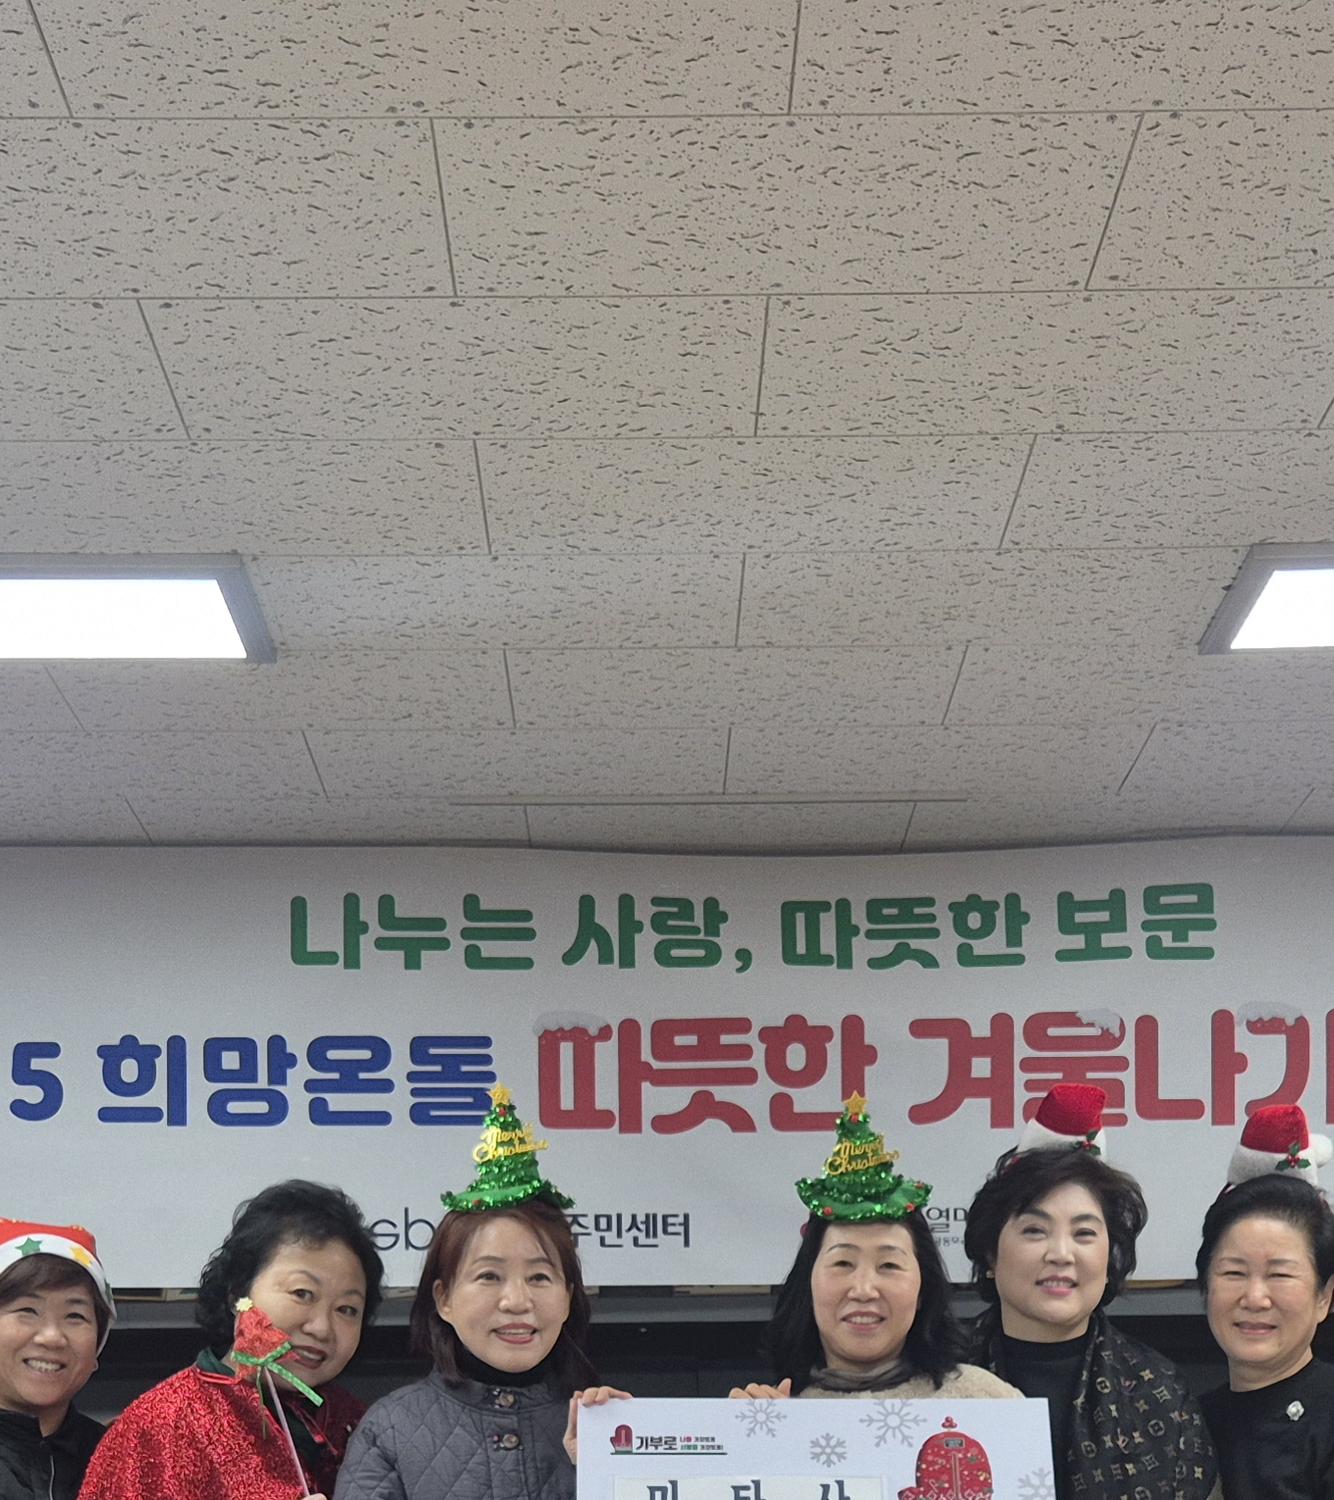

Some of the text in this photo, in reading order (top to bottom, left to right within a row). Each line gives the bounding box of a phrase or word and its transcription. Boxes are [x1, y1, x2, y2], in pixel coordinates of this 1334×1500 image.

[288, 883, 1217, 974] 나누는 사랑, 따뜻한 보문
[97, 1033, 498, 1127] 희망온돌
[535, 1013, 878, 1136] 따뜻한
[636, 1436, 678, 1450] 기부로
